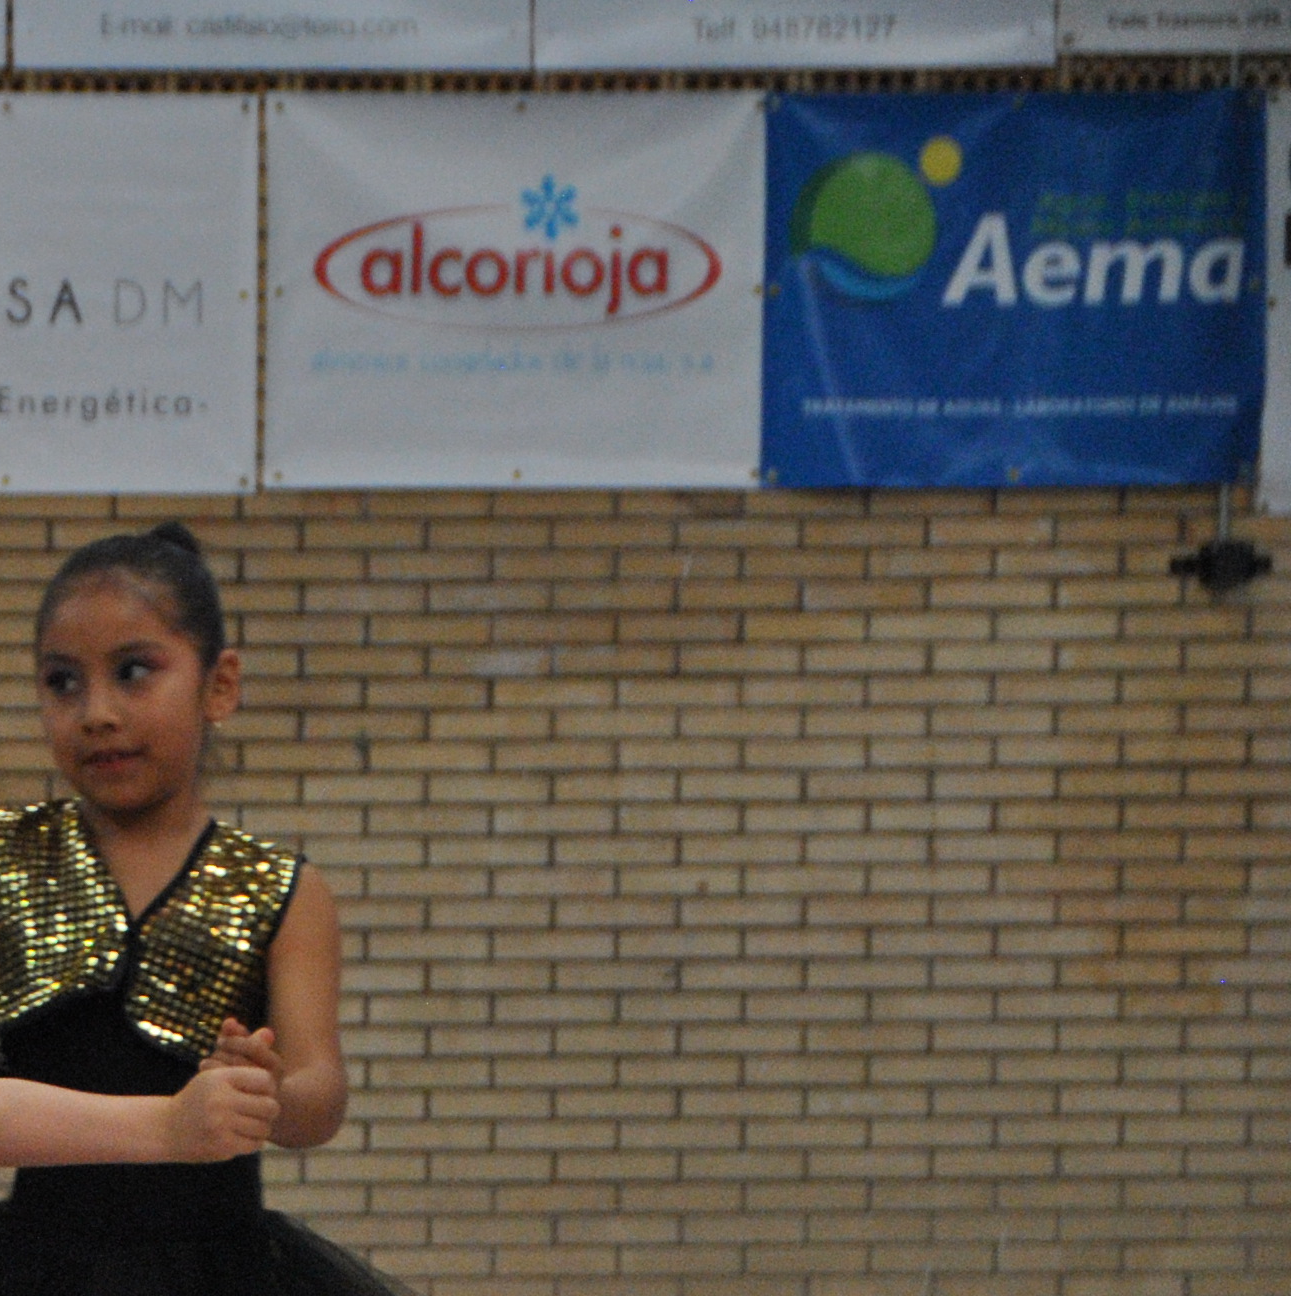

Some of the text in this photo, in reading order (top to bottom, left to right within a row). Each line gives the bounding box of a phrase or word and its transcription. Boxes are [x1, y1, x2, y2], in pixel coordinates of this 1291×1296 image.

[115, 278, 204, 326] DM
[359, 221, 668, 316] alcorioja
[941, 211, 1246, 307] Aema
